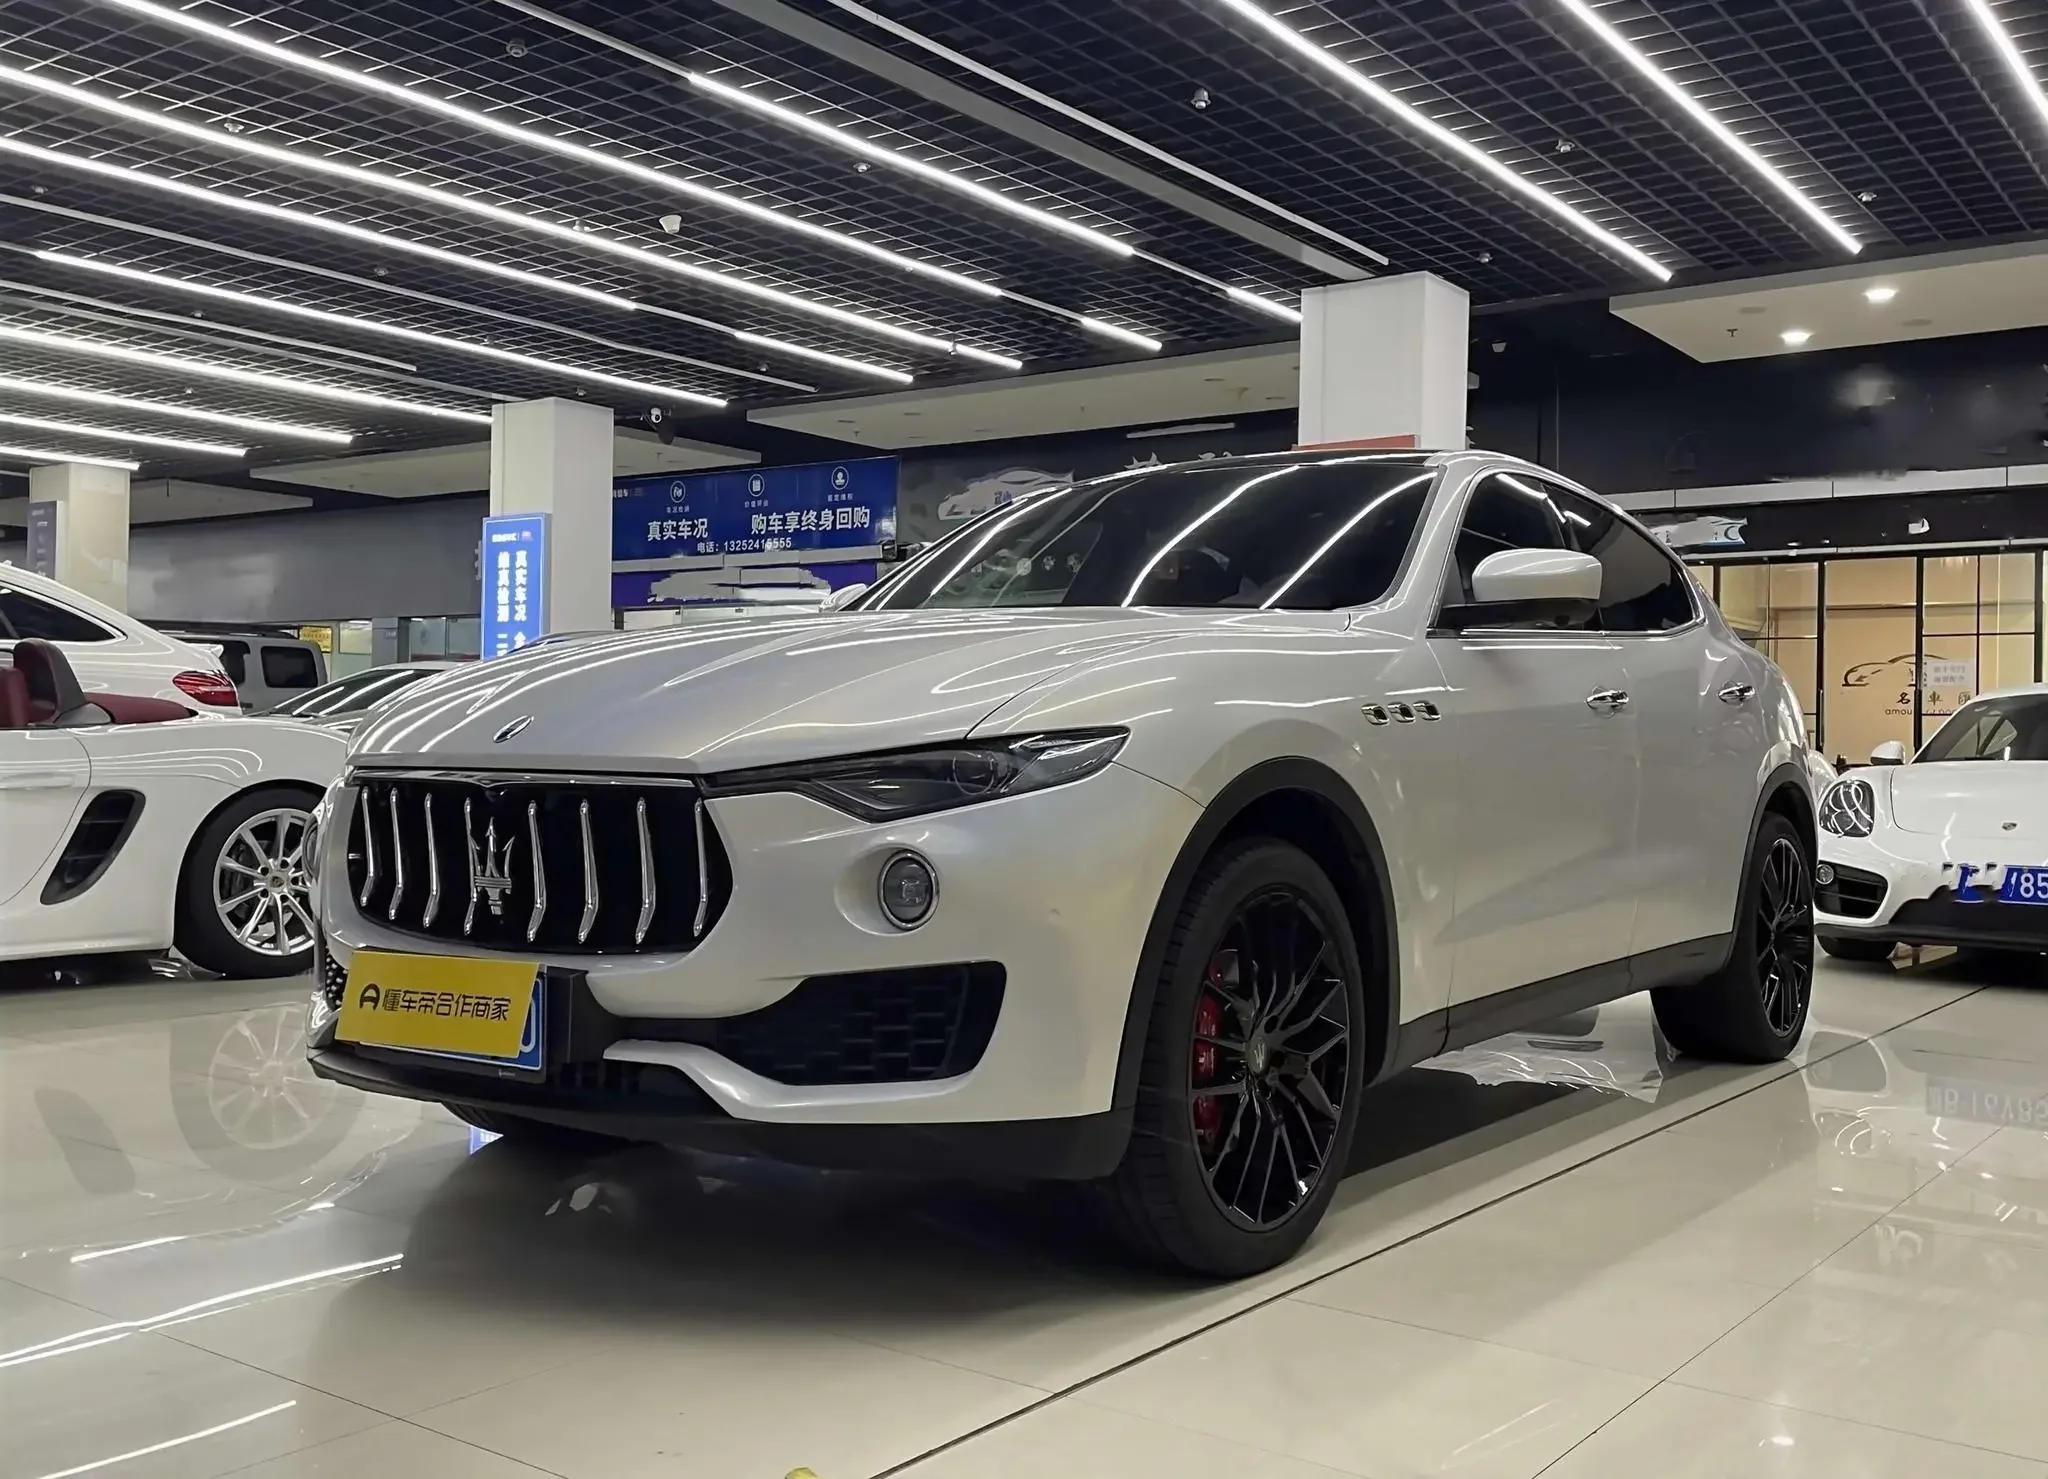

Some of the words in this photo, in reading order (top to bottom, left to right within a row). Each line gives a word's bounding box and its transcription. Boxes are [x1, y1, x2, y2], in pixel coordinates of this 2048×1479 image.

[647, 518, 708, 541] 真实车况
[751, 506, 870, 535] 购车享终身回购
[1885, 708, 1913, 716] amou
[383, 987, 511, 1021] 懂车帝合作商家
